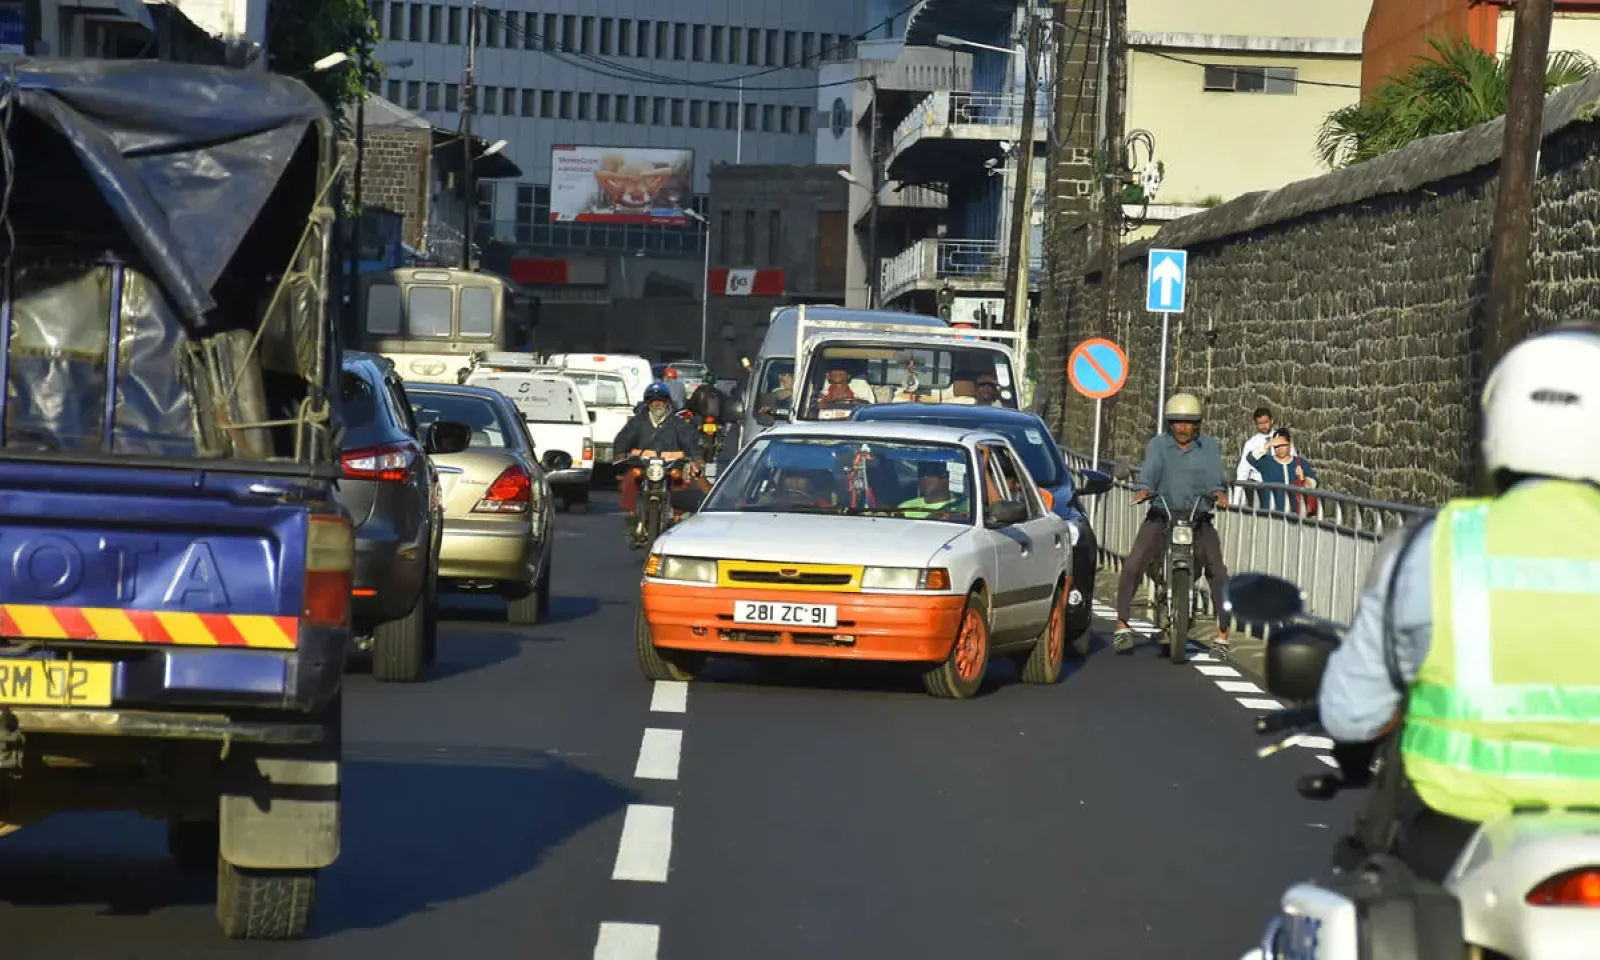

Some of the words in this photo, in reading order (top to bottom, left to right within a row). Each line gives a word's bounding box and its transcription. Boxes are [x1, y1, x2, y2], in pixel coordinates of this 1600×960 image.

[745, 603, 774, 621] 281
[781, 605, 804, 622] ZC
[811, 607, 827, 624] 91
